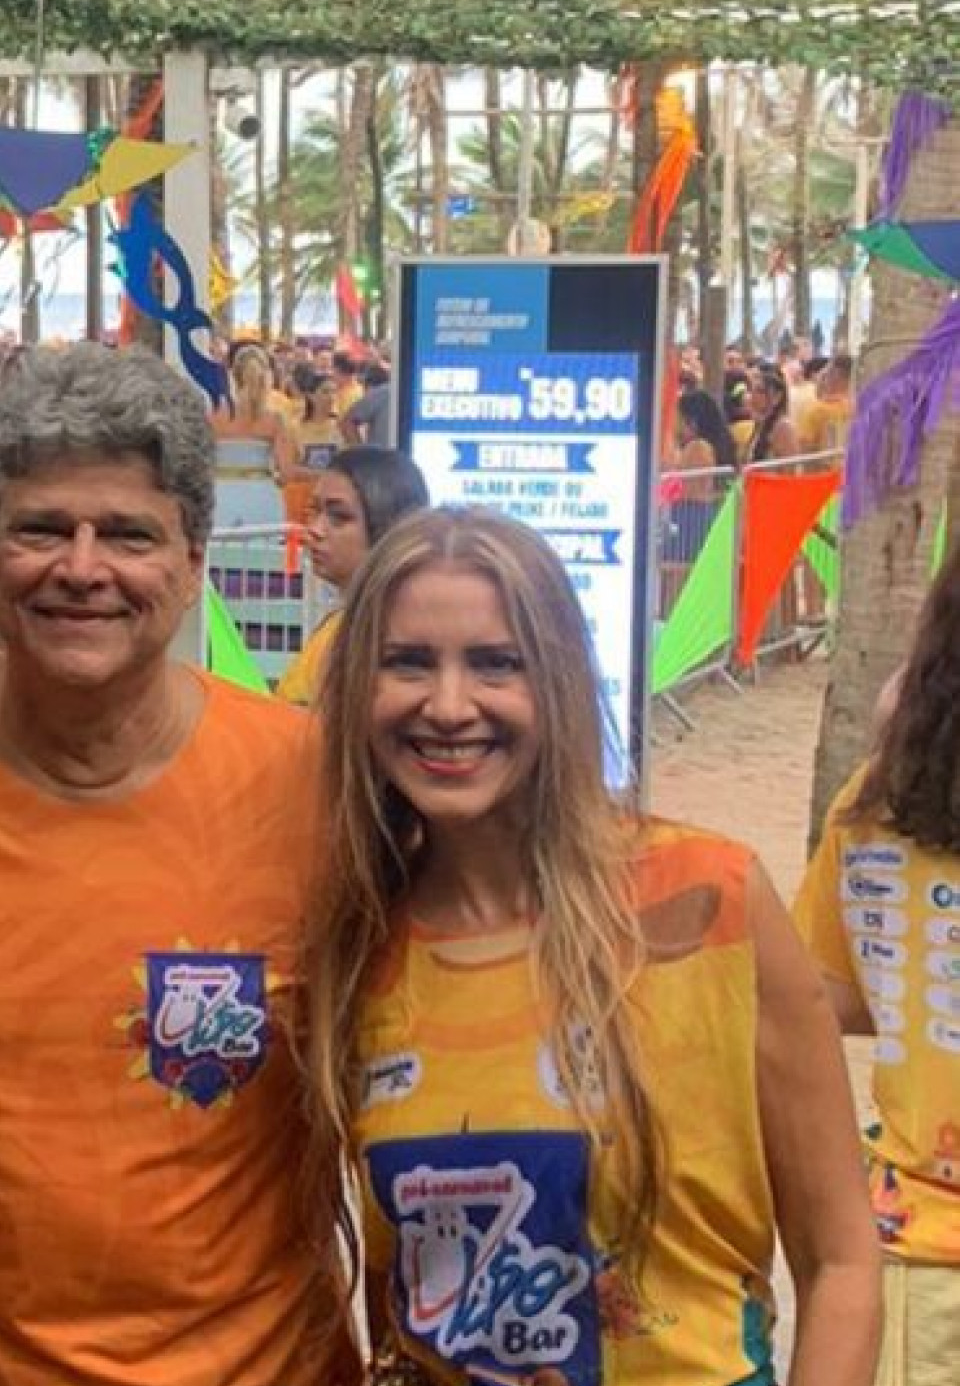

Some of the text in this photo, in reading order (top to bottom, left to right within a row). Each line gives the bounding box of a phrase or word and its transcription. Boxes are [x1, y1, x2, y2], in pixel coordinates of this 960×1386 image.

[421, 367, 479, 393] MENU
[421, 394, 523, 421] EXECUTIVO
[528, 377, 633, 425] 59,90
[478, 444, 567, 469] ENTRADA
[502, 1319, 567, 1355] Bar
